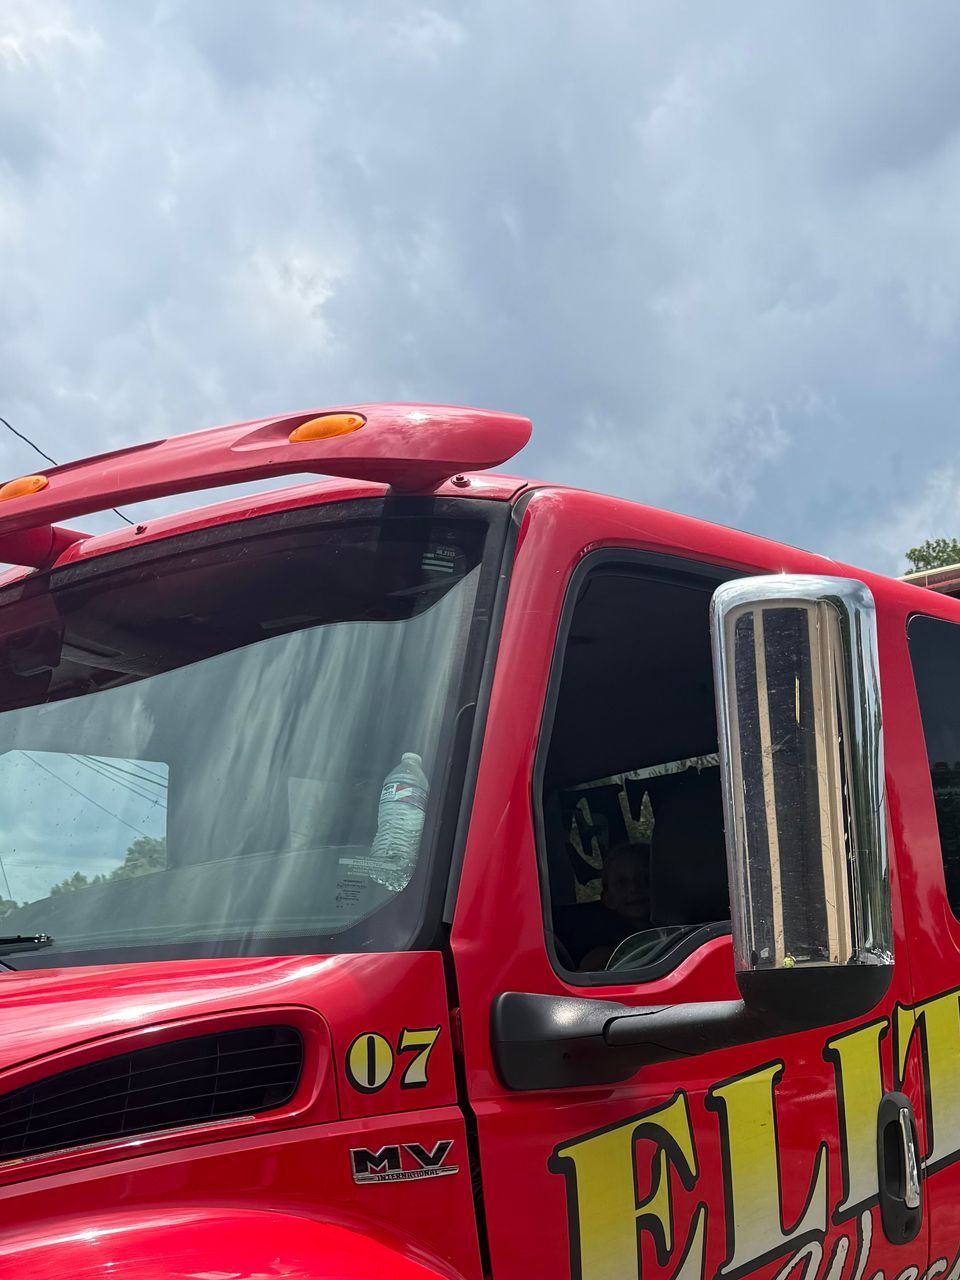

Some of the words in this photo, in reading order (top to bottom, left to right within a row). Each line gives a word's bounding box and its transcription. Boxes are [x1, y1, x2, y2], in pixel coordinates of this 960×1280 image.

[345, 1024, 442, 1094] 07
[349, 1139, 455, 1175] MV
[376, 1169, 440, 1182] INTERNATIONAL
